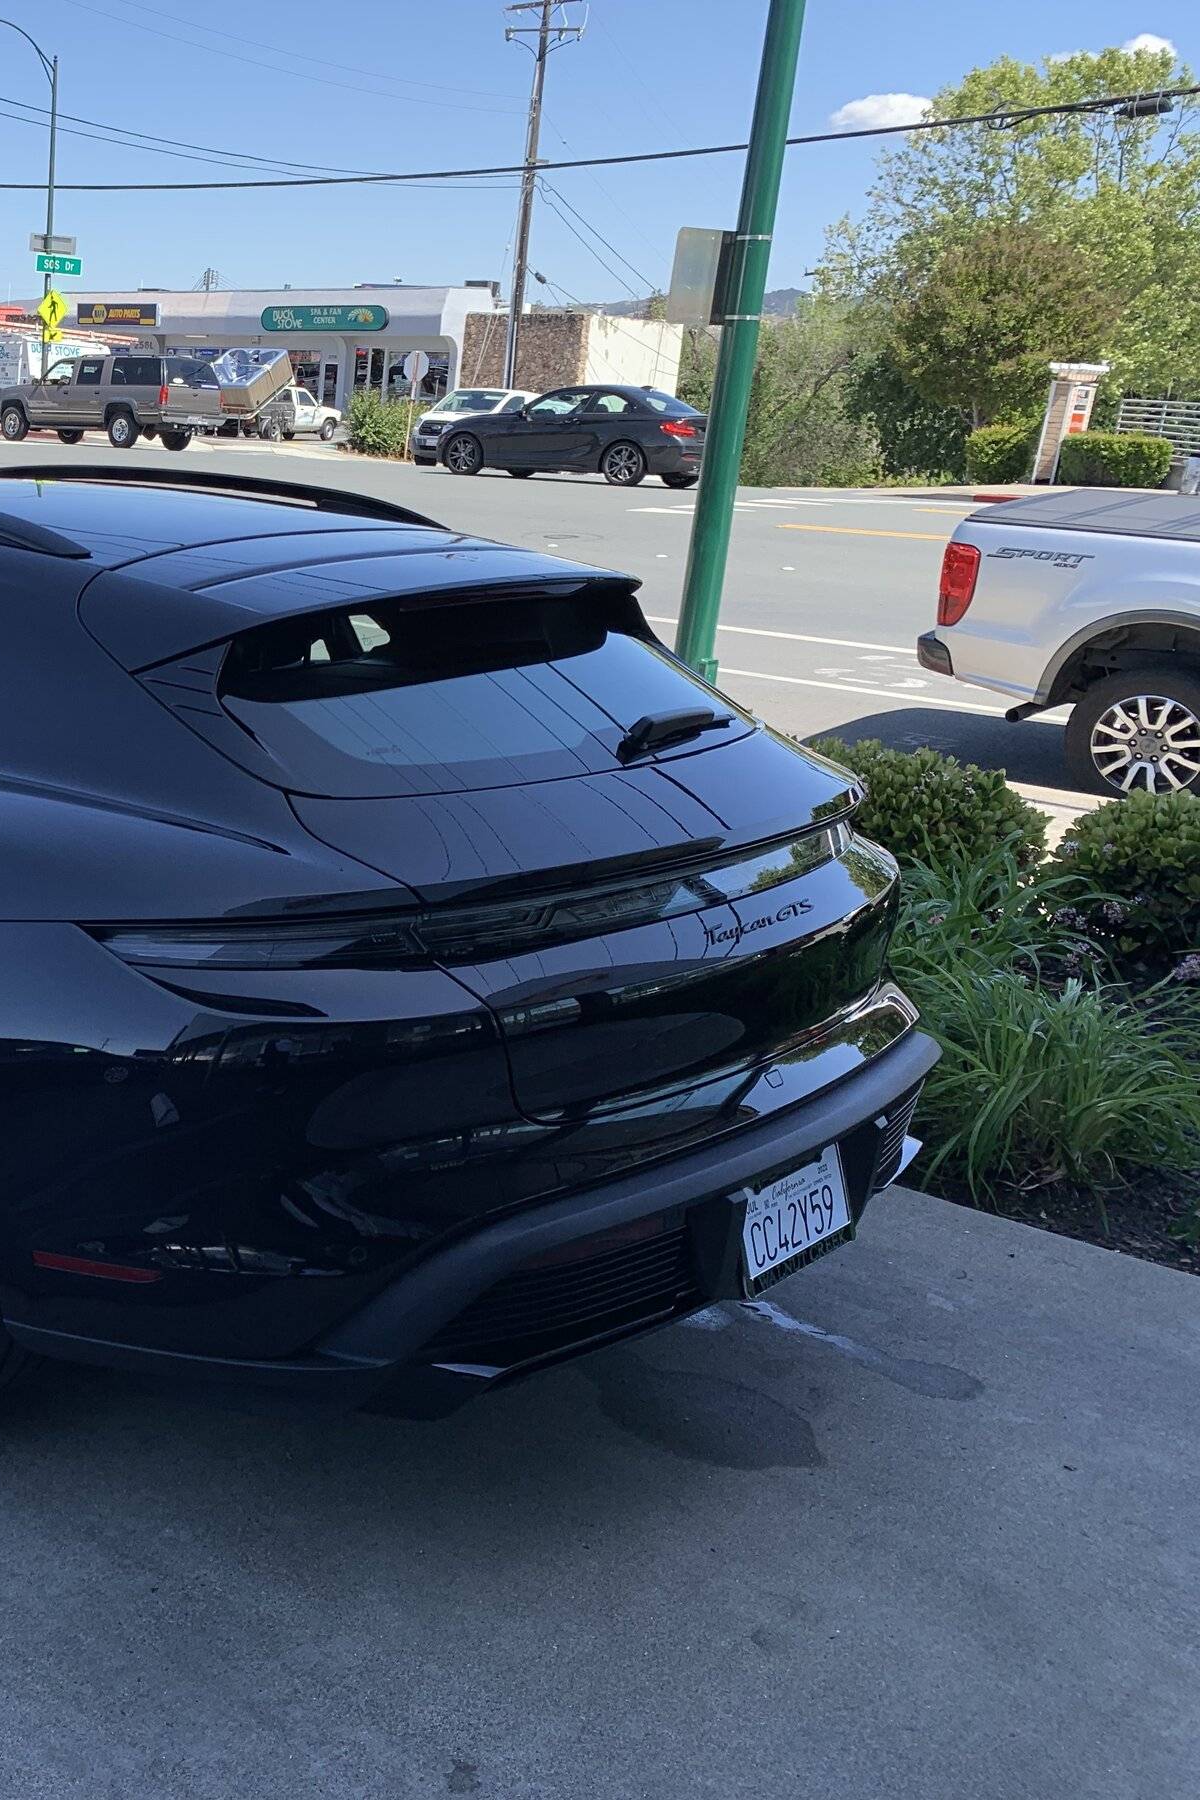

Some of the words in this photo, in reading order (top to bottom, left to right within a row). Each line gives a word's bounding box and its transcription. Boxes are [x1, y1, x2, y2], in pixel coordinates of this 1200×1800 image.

[65, 261, 75, 272] Dr
[107, 309, 123, 319] AUTO
[123, 308, 141, 319] PARTS
[310, 308, 322, 316] SPA
[277, 319, 303, 329] STOVE
[313, 316, 336, 324] CENTER
[55, 345, 80, 357] STOVE
[986, 547, 1096, 563] SPORT
[704, 916, 776, 945] Taycan
[776, 899, 814, 922] GTS
[771, 1178, 806, 1201] California
[750, 1184, 834, 1268] CC42Y59
[809, 1232, 846, 1261] CREEK
